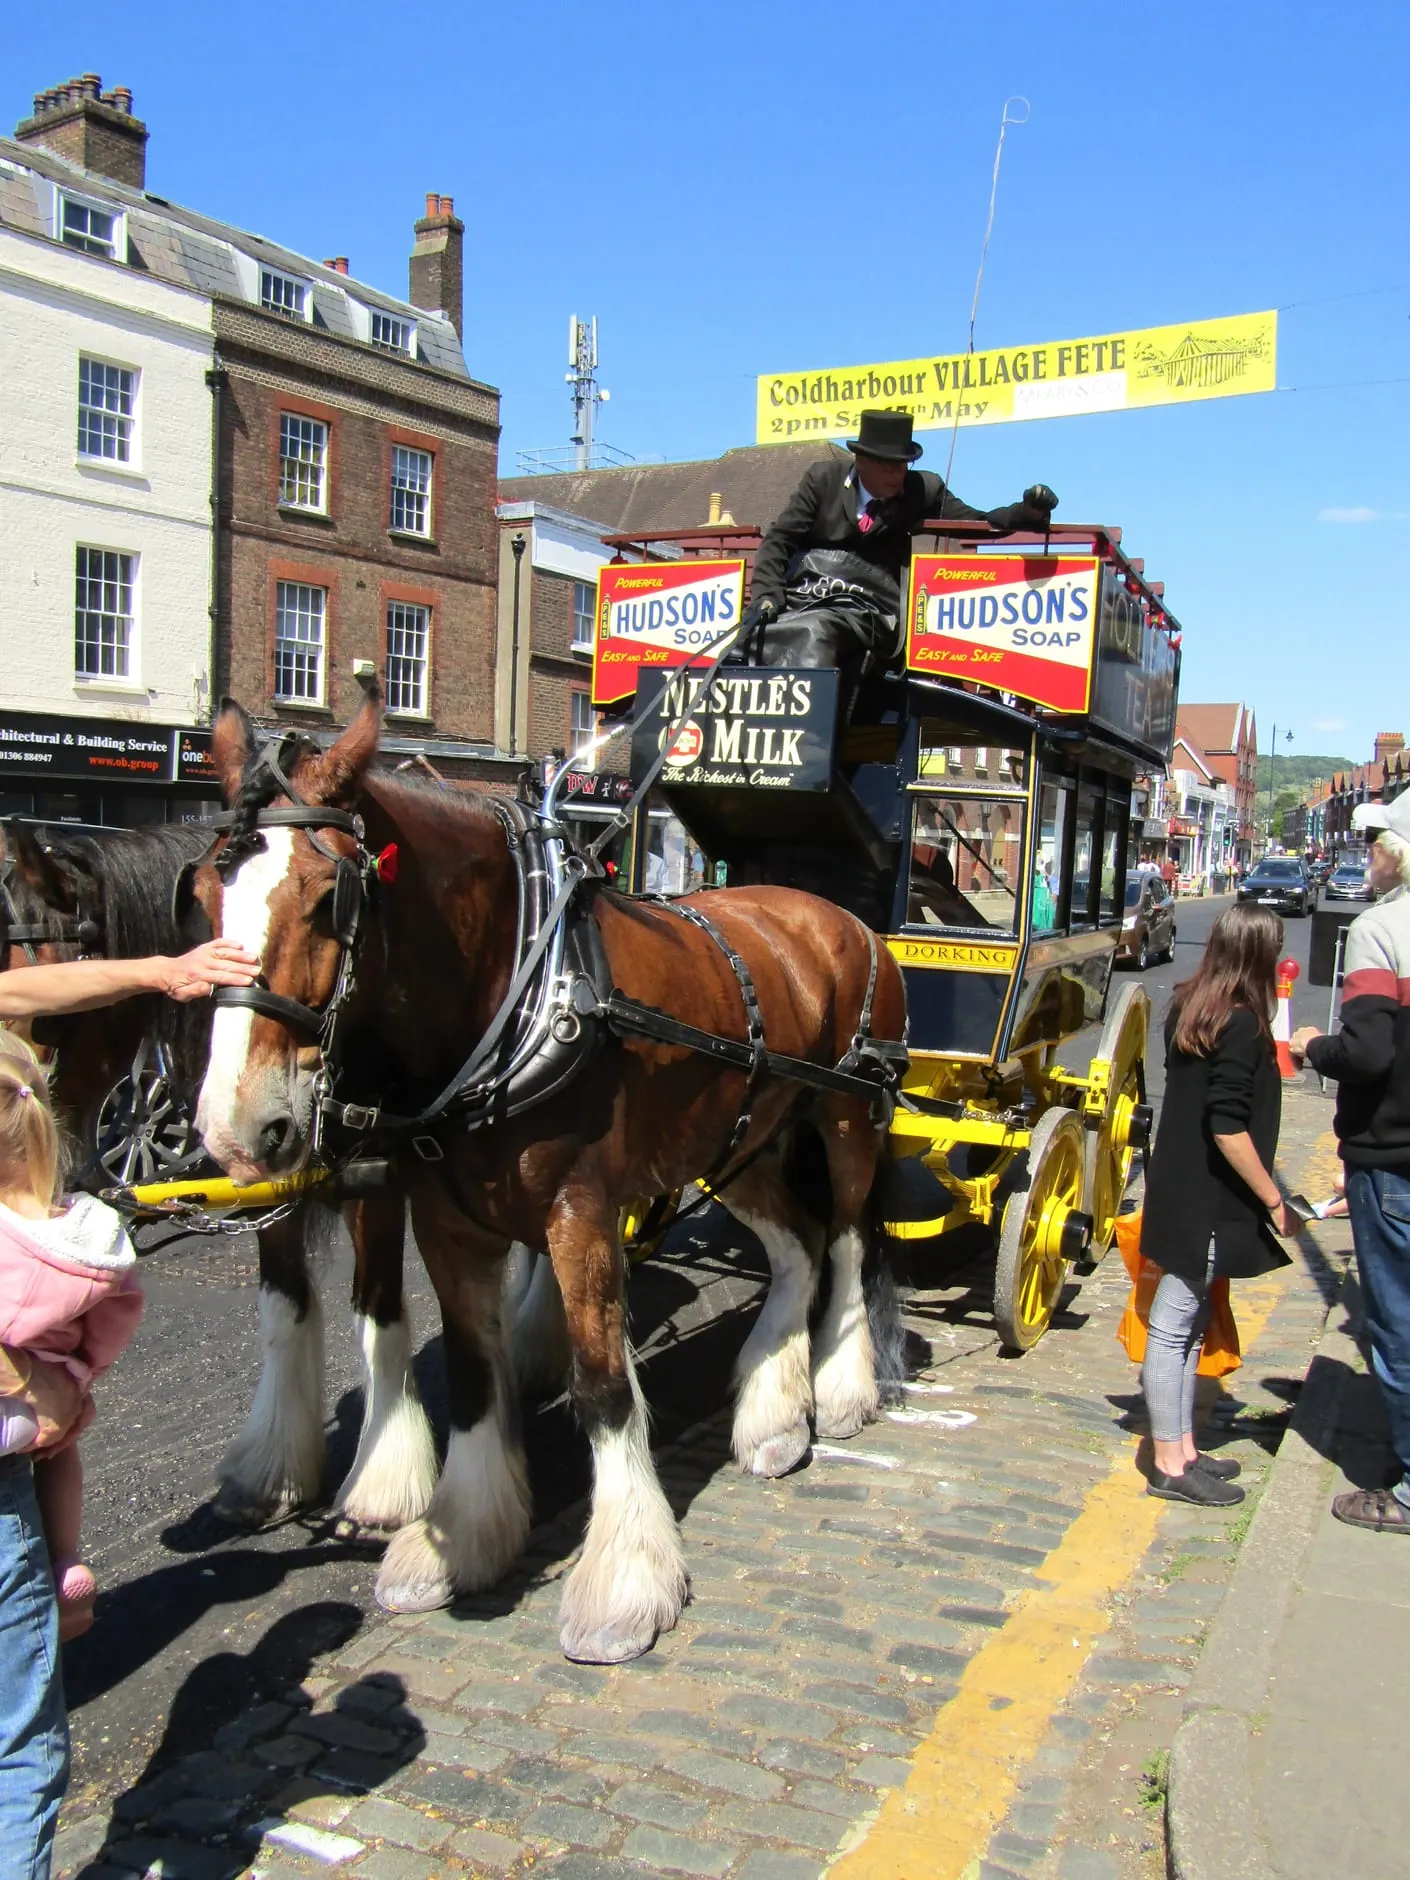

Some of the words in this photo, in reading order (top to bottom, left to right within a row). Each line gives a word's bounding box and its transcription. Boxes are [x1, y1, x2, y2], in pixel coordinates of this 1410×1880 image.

[770, 370, 927, 407] Coldharbour
[933, 350, 1047, 391] VILLAGE
[1057, 339, 1126, 377] FETE
[771, 416, 828, 436] 2pm
[835, 410, 860, 428] Sa
[930, 400, 989, 420] May
[614, 577, 665, 590] POWERFUL
[933, 567, 997, 581] POWERFUL
[616, 584, 734, 634] HUDSON'S
[937, 581, 1089, 630] HUDSON'S
[1011, 628, 1081, 647] SOAP
[601, 650, 628, 663] EASY
[643, 649, 670, 662] SAFE
[915, 647, 950, 661] EASY
[949, 654, 967, 662] AND
[970, 648, 1005, 663] SAFE
[0, 728, 60, 745] hitectural
[64, 733, 75, 746] &
[77, 734, 126, 752] Building
[128, 738, 168, 753] Service
[710, 718, 805, 766] MILK
[88, 757, 159, 771] www.ob.group
[686, 766, 737, 784] Richest
[736, 773, 746, 784] in
[905, 944, 1007, 963] DORKING
